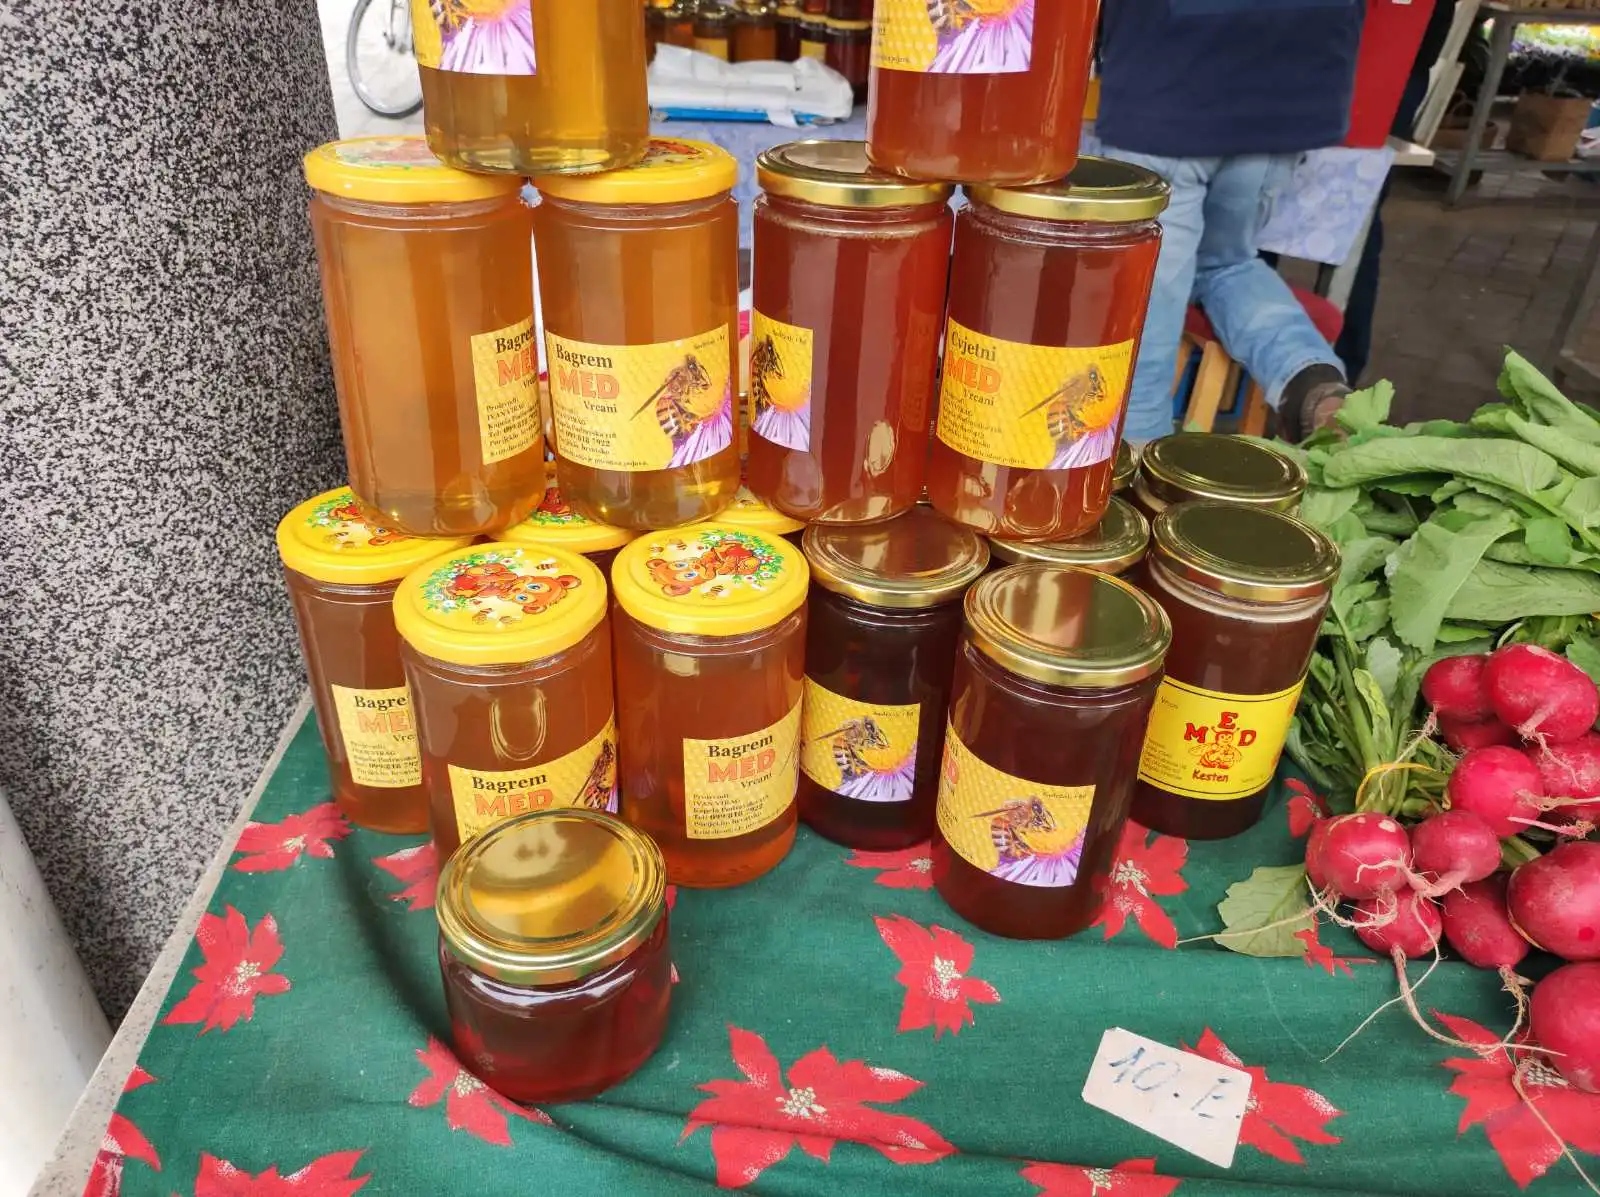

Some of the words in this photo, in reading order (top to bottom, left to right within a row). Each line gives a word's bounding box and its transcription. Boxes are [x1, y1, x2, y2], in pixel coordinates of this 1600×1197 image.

[556, 343, 613, 369] Bagrem
[951, 329, 997, 362] Cvjetni
[558, 365, 620, 400] MED
[947, 352, 1001, 394] MED
[583, 400, 617, 414] Vrcani
[708, 735, 773, 759] Bagrem
[708, 748, 776, 783] MED
[1192, 769, 1229, 783] Kesten
[472, 774, 548, 794] Bagrem
[740, 771, 773, 789] Vrcani
[474, 789, 554, 817] MED
